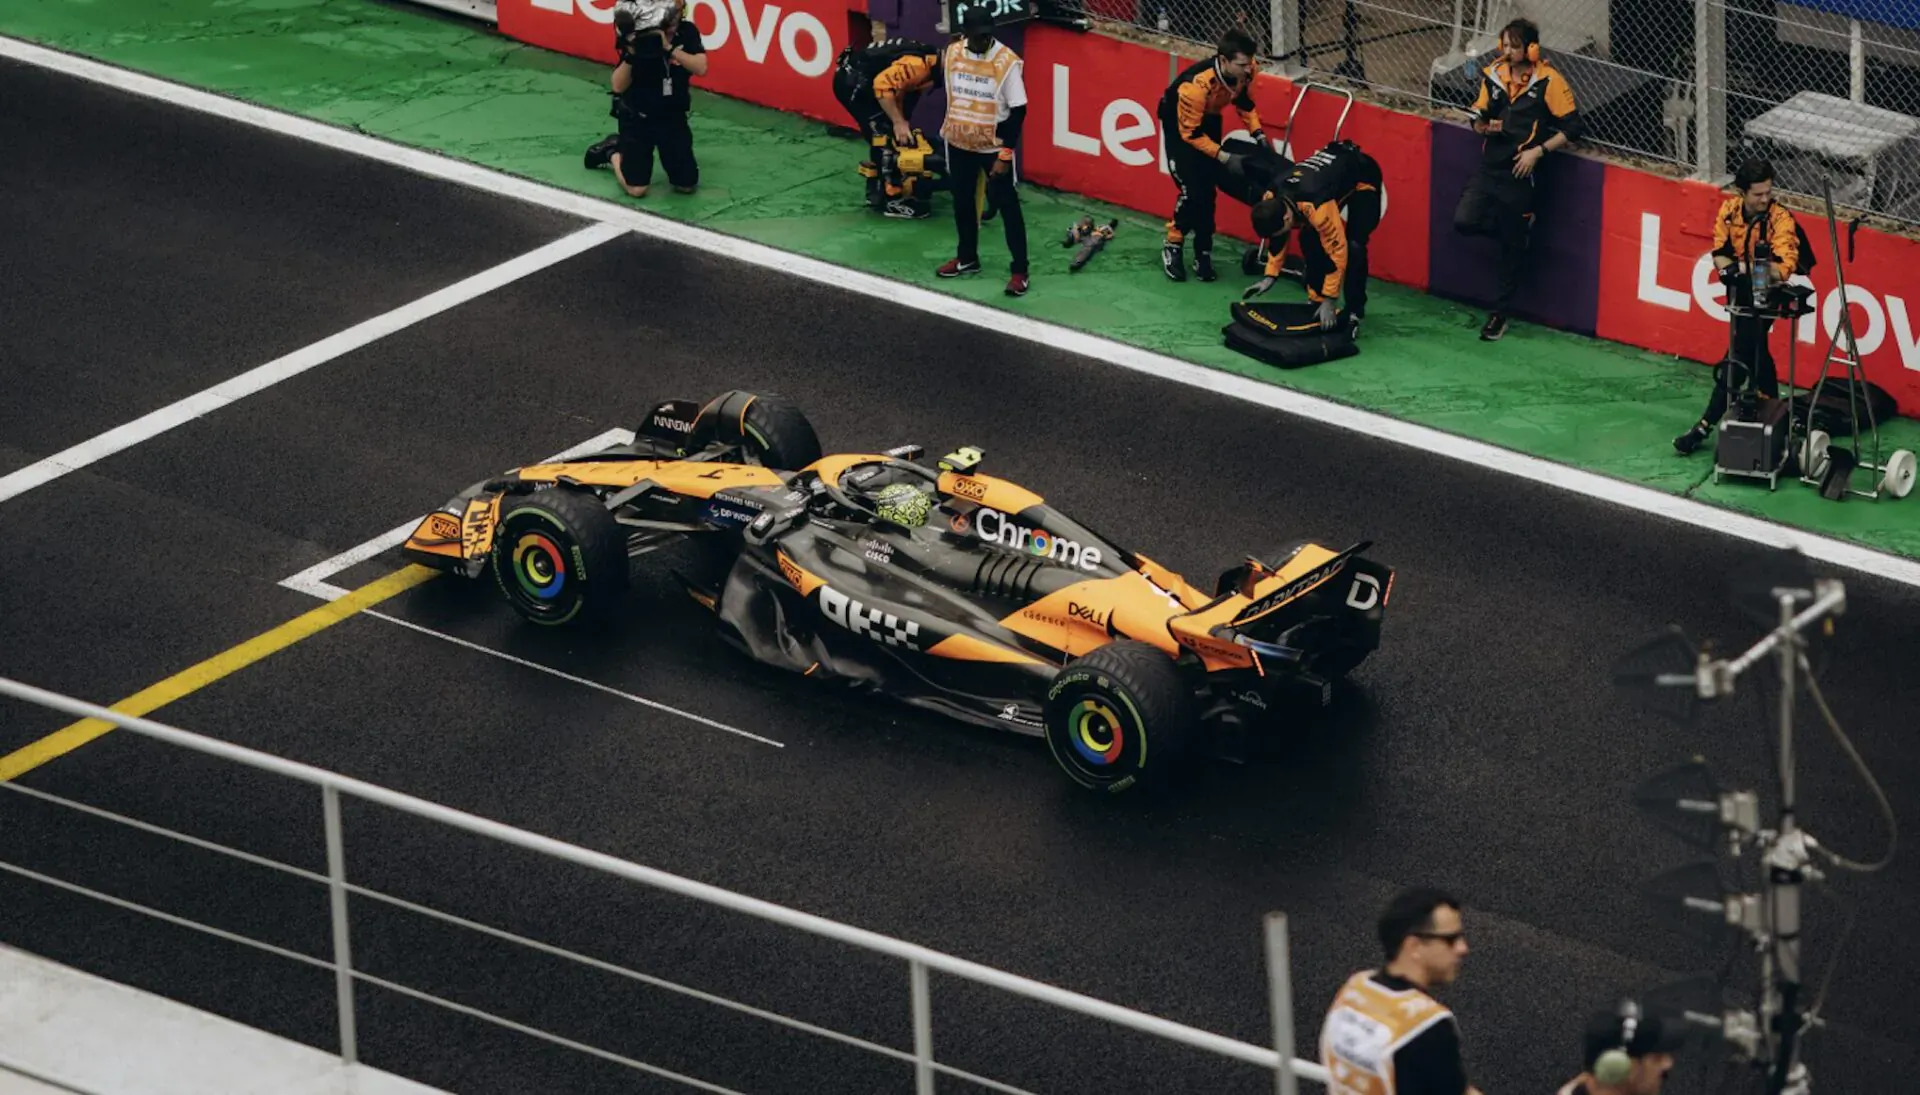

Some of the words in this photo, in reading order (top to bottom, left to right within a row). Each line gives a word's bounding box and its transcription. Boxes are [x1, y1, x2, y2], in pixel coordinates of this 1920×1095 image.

[953, 478, 987, 498] OXXO
[732, 510, 753, 523] WOR
[976, 507, 1102, 570] Chrome
[1346, 572, 1380, 610] D
[1068, 602, 1105, 627] DELL
